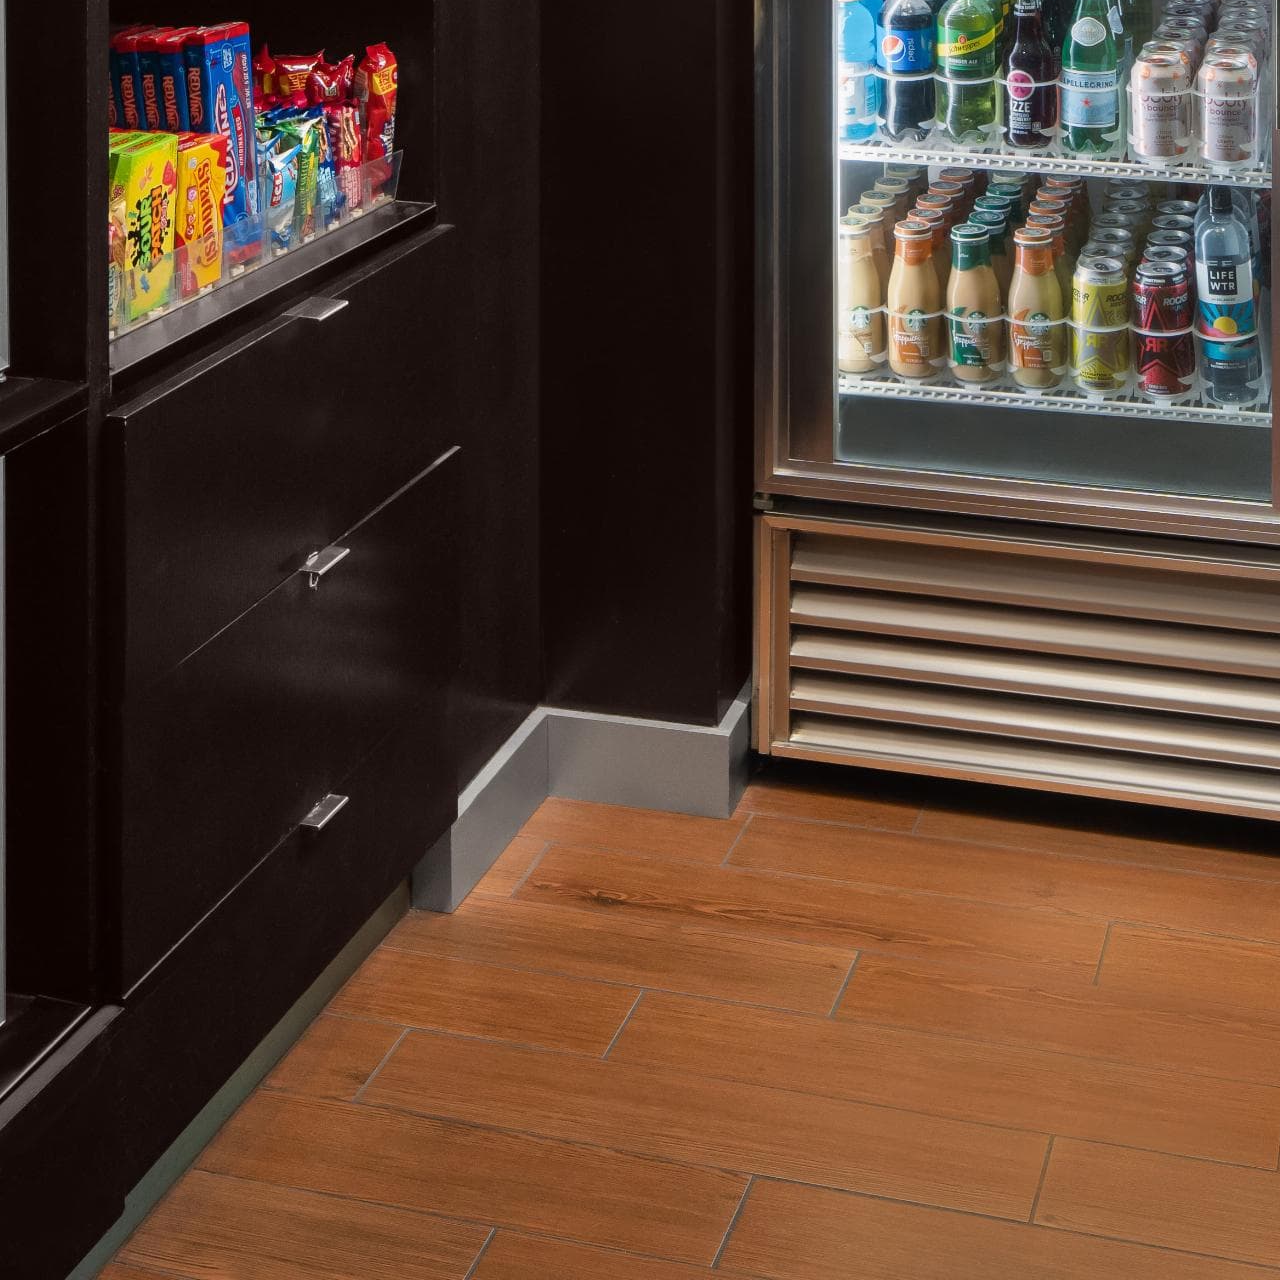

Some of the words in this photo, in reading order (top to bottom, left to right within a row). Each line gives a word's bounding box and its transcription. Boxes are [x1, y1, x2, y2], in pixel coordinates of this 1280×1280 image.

[907, 38, 915, 62] pepsi
[140, 196, 152, 266] SOUR
[1210, 270, 1235, 280] LIFE
[1210, 281, 1236, 291] WTR
